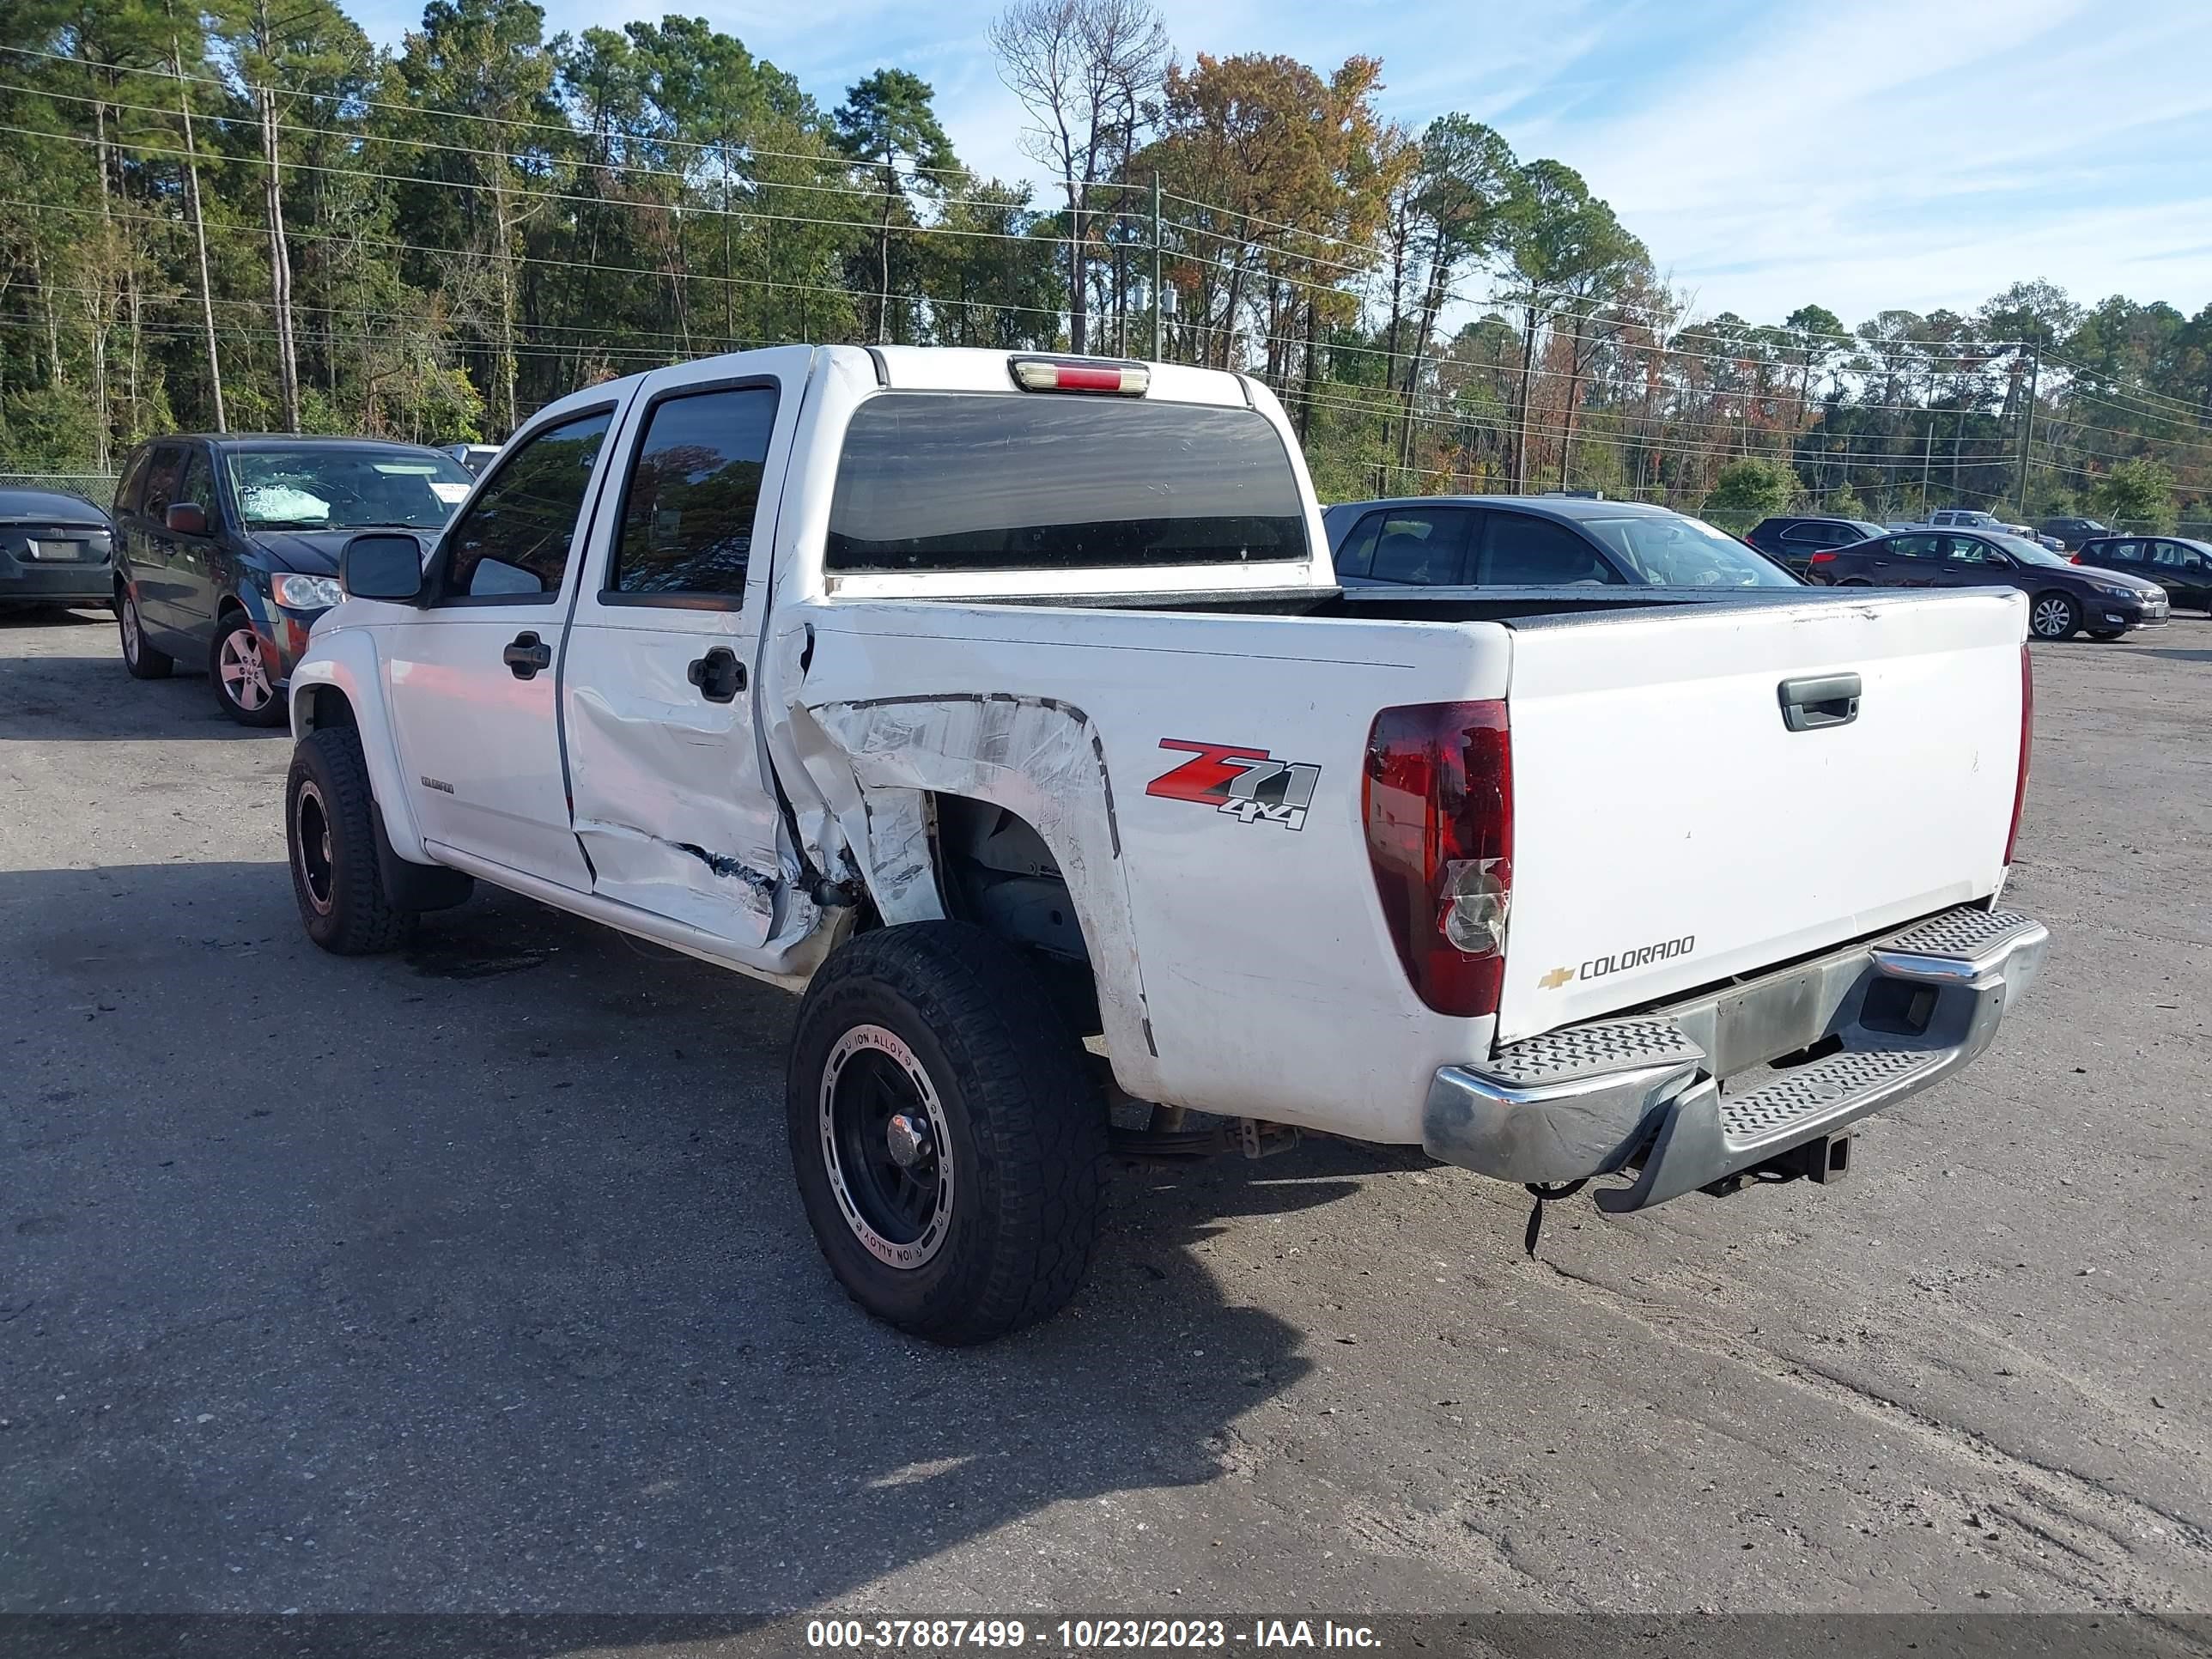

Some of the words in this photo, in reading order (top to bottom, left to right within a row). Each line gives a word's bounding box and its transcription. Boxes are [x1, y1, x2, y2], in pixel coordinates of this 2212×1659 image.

[1146, 738, 1322, 809] Z71
[1579, 934, 1695, 981] COLORADO
[854, 1033, 870, 1047] ION
[874, 1034, 903, 1058] ALLOY
[864, 1231, 893, 1258] ALLOY
[896, 1249, 913, 1262] ION
